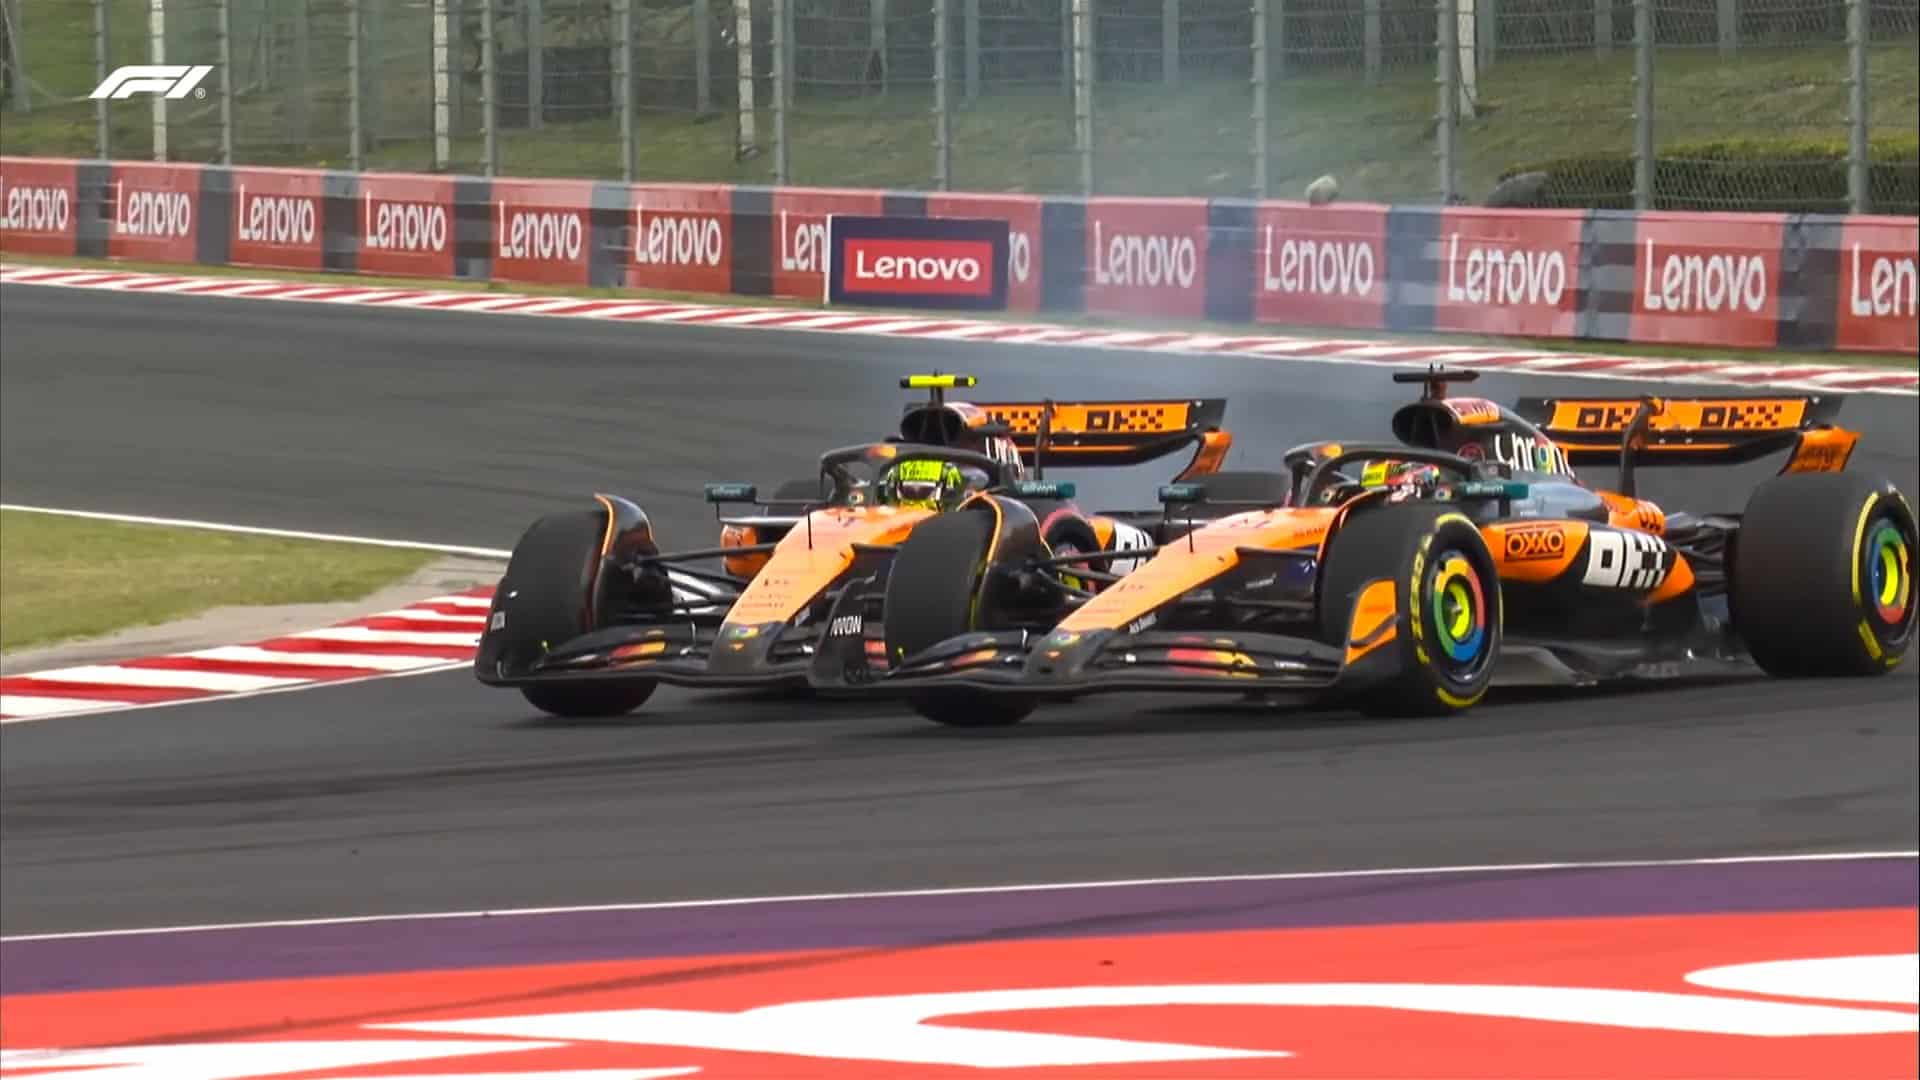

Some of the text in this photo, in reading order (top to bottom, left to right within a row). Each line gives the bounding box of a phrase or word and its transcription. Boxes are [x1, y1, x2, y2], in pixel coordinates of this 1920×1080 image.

[0, 176, 69, 231] Lenovo
[115, 179, 191, 236] Lenovo
[238, 183, 315, 244] Lenovo
[365, 191, 447, 252] Lenovo
[498, 199, 582, 260] Lenovo
[634, 203, 722, 266] Lenovo
[780, 208, 826, 272] Len
[1094, 220, 1196, 289] Lenovo
[1264, 224, 1374, 297] Lenovo
[856, 250, 980, 281] Lenovo
[1447, 232, 1566, 305] Lenovo
[1643, 238, 1767, 311] Lenovo
[1850, 242, 1918, 317] Len
[1701, 405, 1783, 428] OKX
[1507, 529, 1564, 554] OXXO
